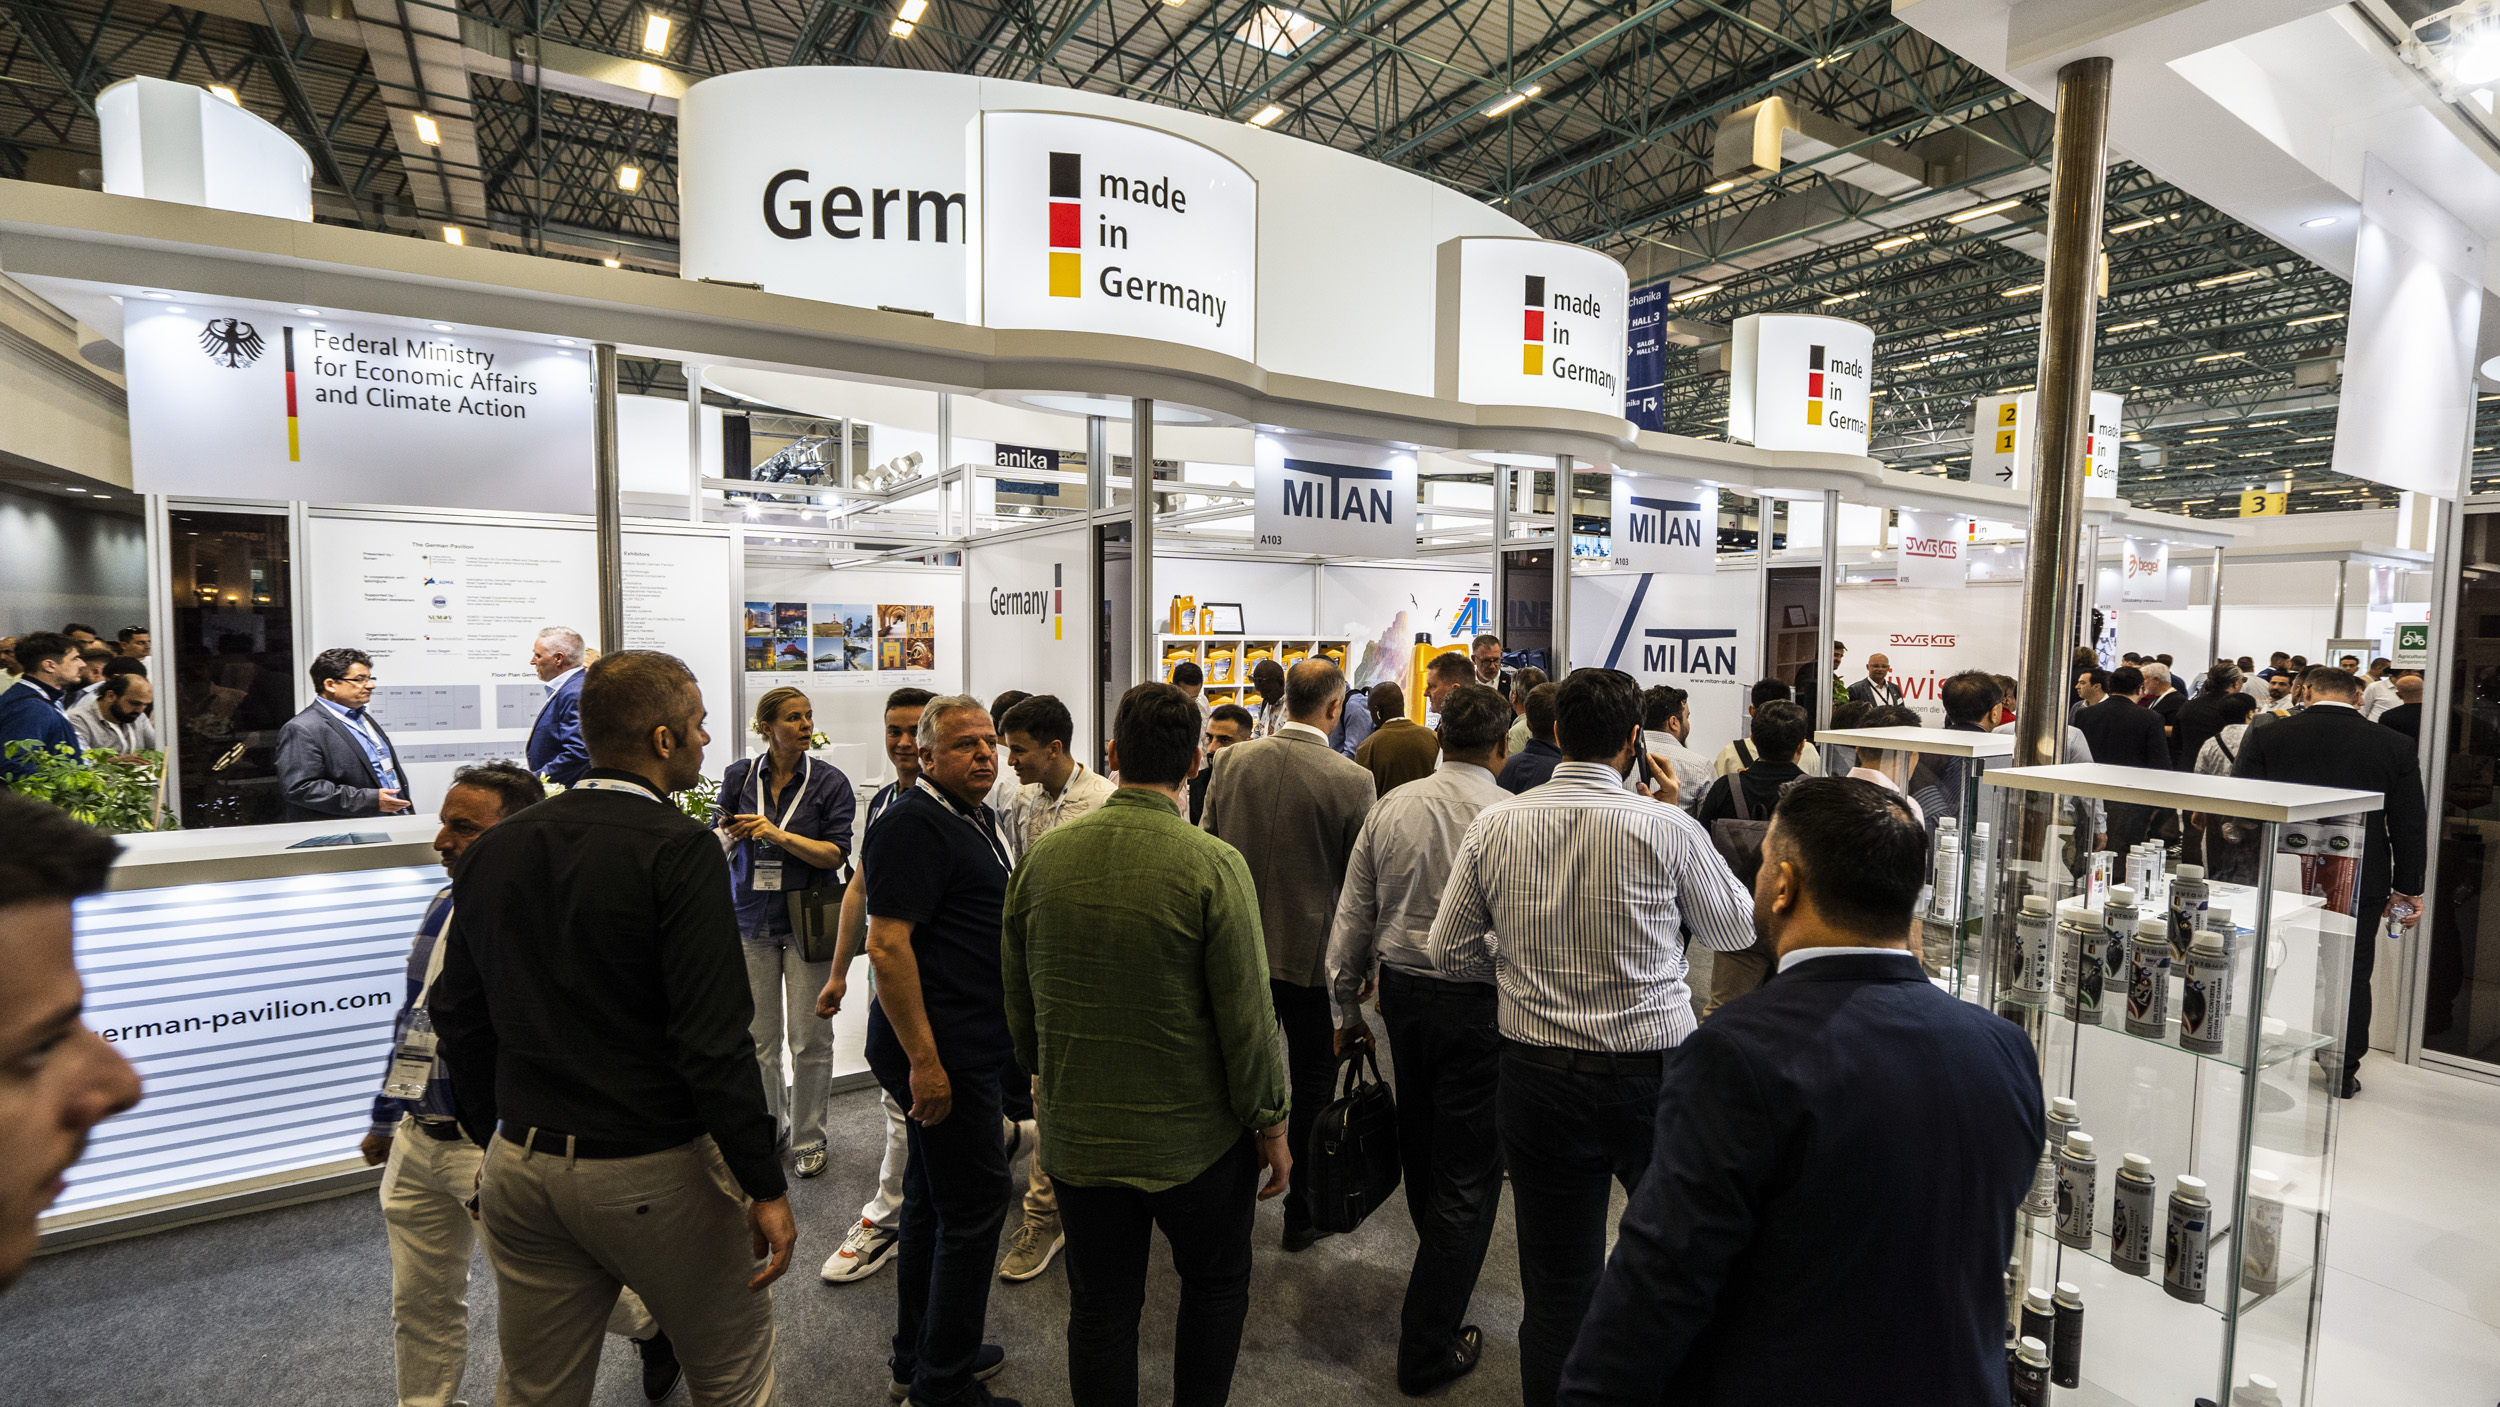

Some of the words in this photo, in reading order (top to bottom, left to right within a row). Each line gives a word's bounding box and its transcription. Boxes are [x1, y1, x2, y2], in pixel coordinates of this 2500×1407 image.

[1099, 172, 1186, 214] made
[1099, 214, 1128, 250] in
[1099, 266, 1227, 328] Germany
[1553, 293, 1601, 319] made
[1552, 321, 1570, 345] in
[1632, 315, 1652, 328] HALL
[1653, 311, 1661, 322] 3
[314, 329, 399, 357] Federal
[406, 339, 495, 370] Ministry
[314, 356, 347, 378] for
[355, 359, 464, 389] Economic
[470, 372, 538, 396] Affairs
[1552, 357, 1617, 397] Germany
[1831, 358, 1863, 379] made
[315, 385, 358, 405] and
[366, 387, 452, 413] Climate
[458, 395, 526, 419] Action
[1829, 381, 1842, 401] in
[2005, 407, 2016, 421] 2
[2003, 434, 2012, 448] 1
[2097, 441, 2106, 456] in
[997, 449, 1048, 470] anika
[1283, 457, 1393, 525] MITAN
[2251, 496, 2266, 513] 3
[1629, 495, 1702, 547] MITAN
[1260, 534, 1282, 545] A103
[1614, 557, 1629, 566] A103
[990, 586, 1049, 624] Germany
[1643, 628, 1737, 676] MITAN
[94, 991, 392, 1043] erman-pavilion.com
